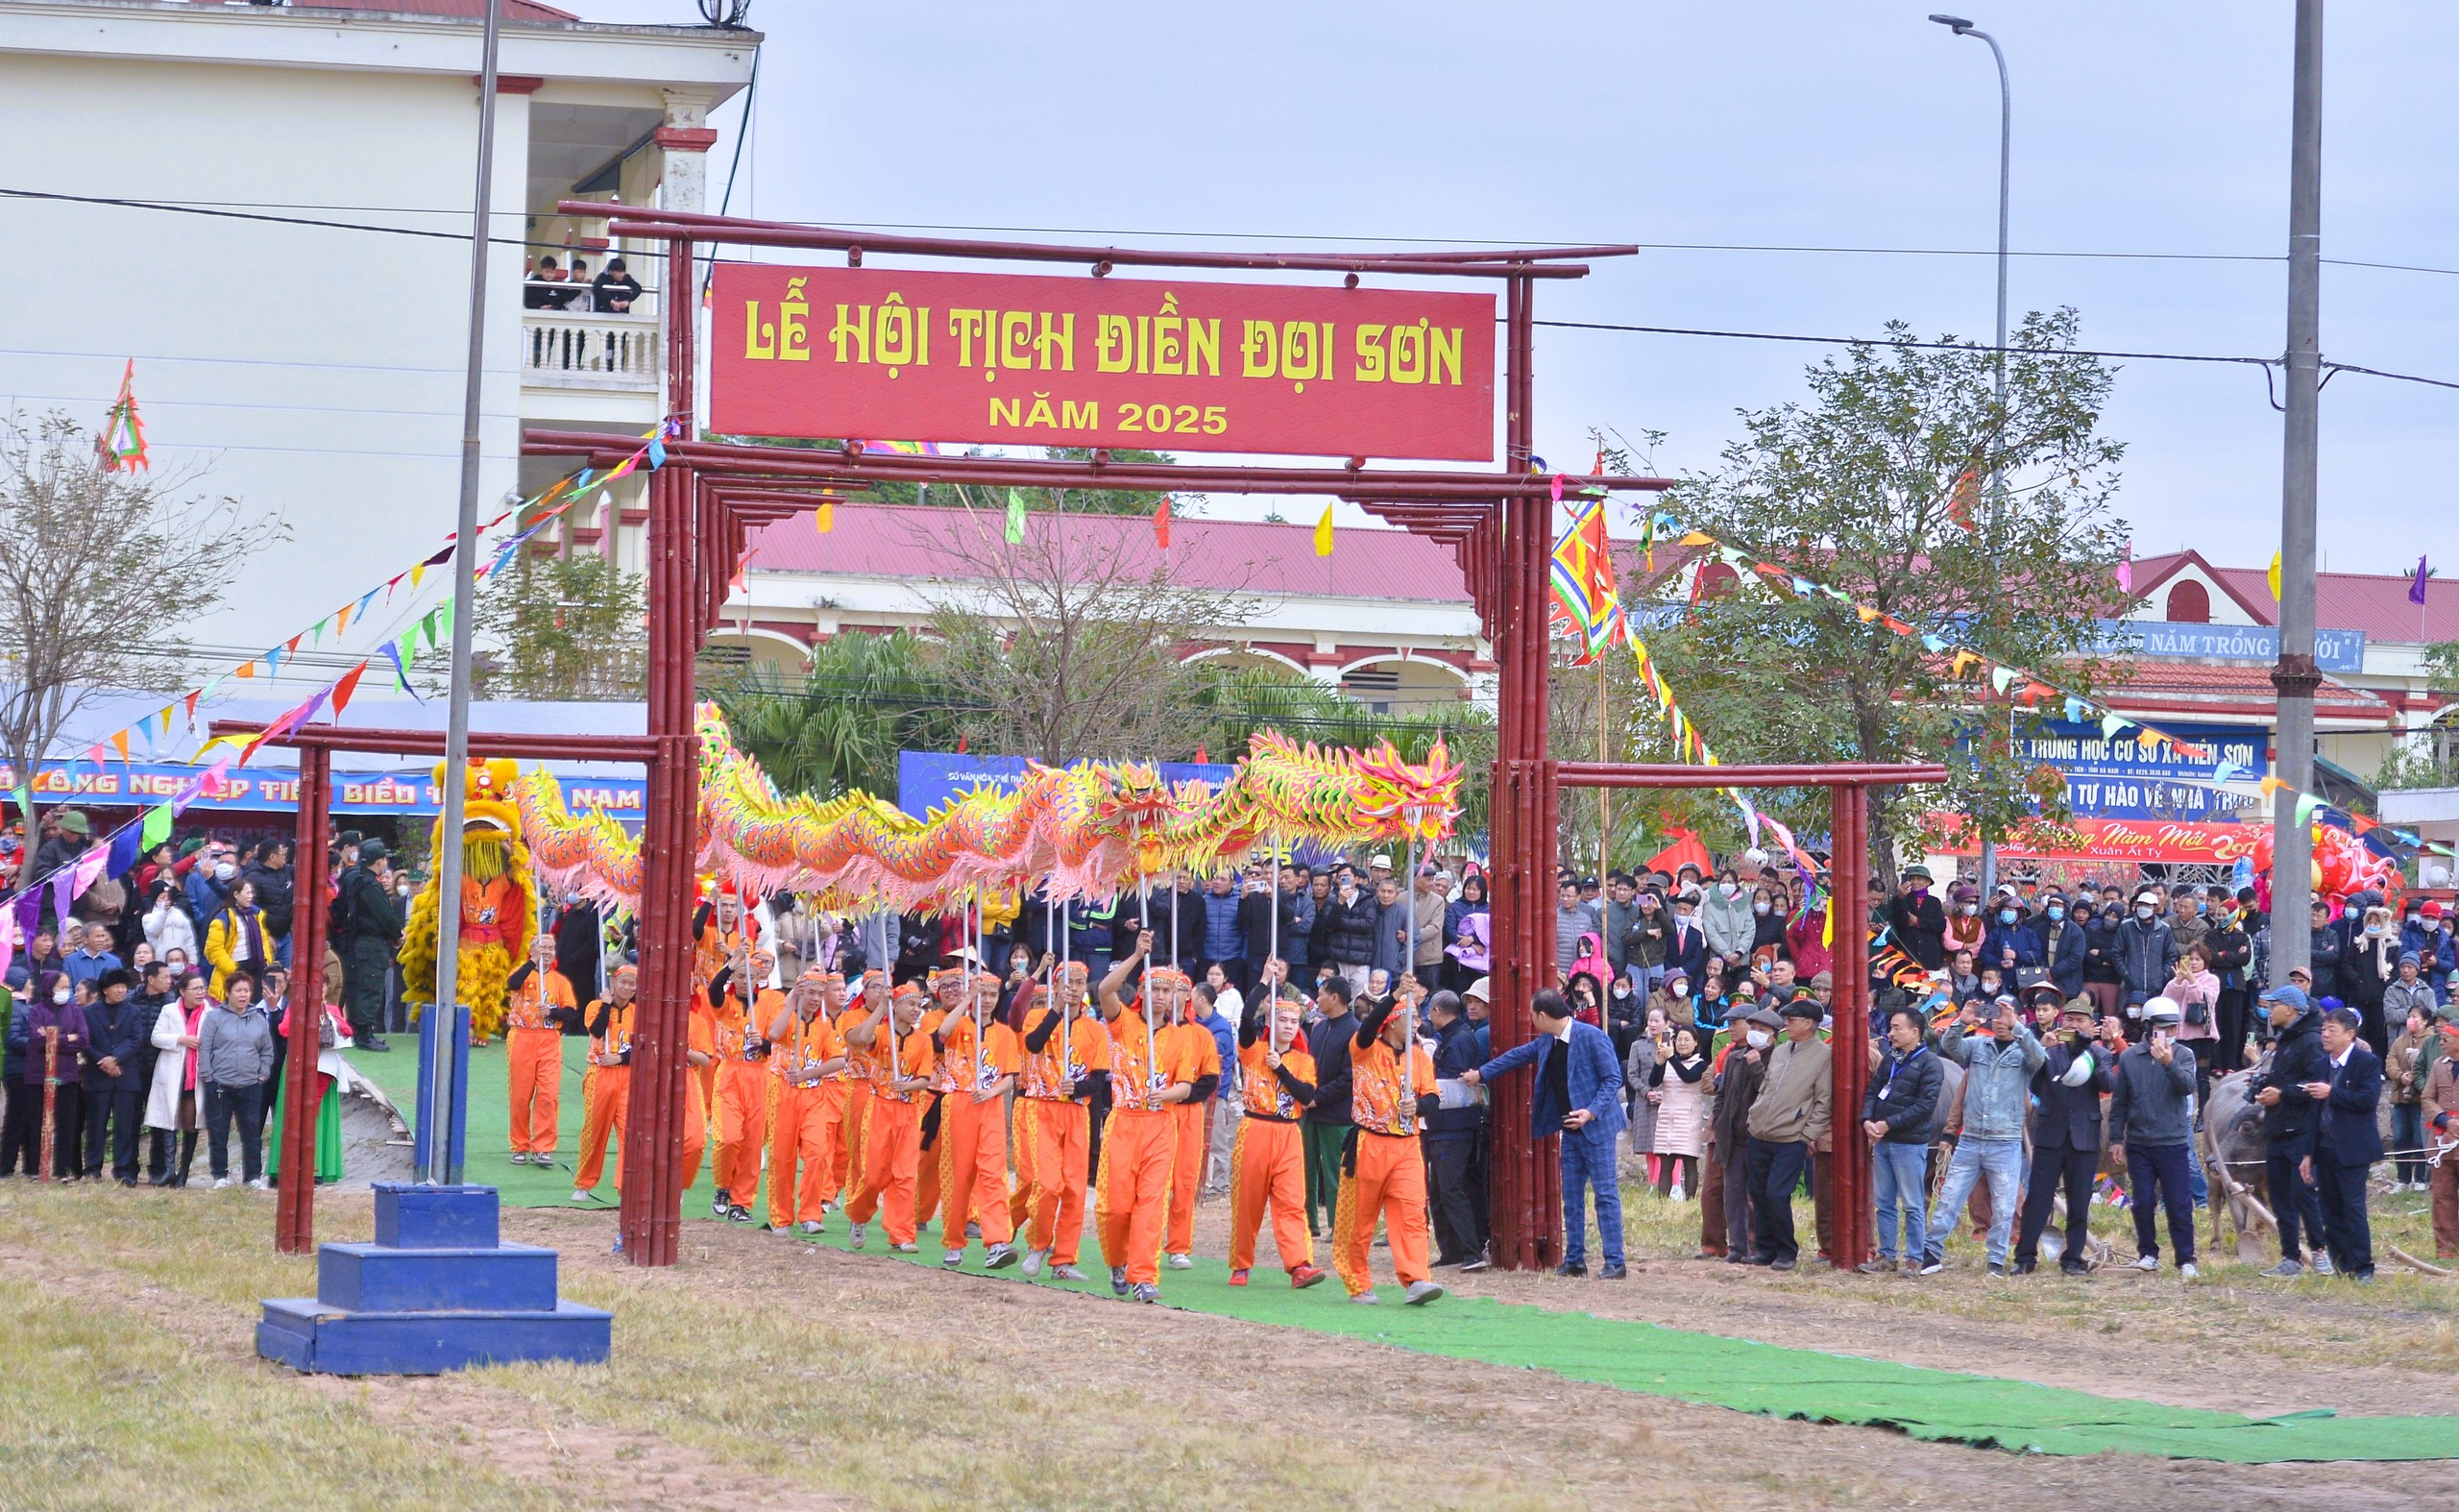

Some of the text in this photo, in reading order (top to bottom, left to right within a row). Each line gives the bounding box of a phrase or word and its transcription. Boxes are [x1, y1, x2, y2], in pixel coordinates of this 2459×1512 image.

[746, 278, 1463, 393] LỄ HỘI TỊCH ĐIỀN ĐỌI SƠN
[989, 391, 1228, 434] NĂM 2025
[2151, 629, 2196, 653] NĂM
[2203, 629, 2271, 657] TRỒNG
[2031, 739, 2078, 760] TRUNG
[2082, 739, 2110, 765] HỌC
[2114, 739, 2135, 763] CƠ
[2224, 743, 2253, 768] SƠN
[259, 777, 331, 803] TIÊ
[342, 777, 417, 805] BIỂU
[572, 788, 643, 809] NAM
[1010, 775, 1025, 784] THA
[2078, 782, 2101, 811] TỰ
[2105, 781, 2139, 808] HÀO
[2090, 845, 2123, 856] Xuân
[2127, 844, 2142, 857] Ất
[2103, 822, 2155, 846] Năm
[2158, 824, 2210, 850] Mới
